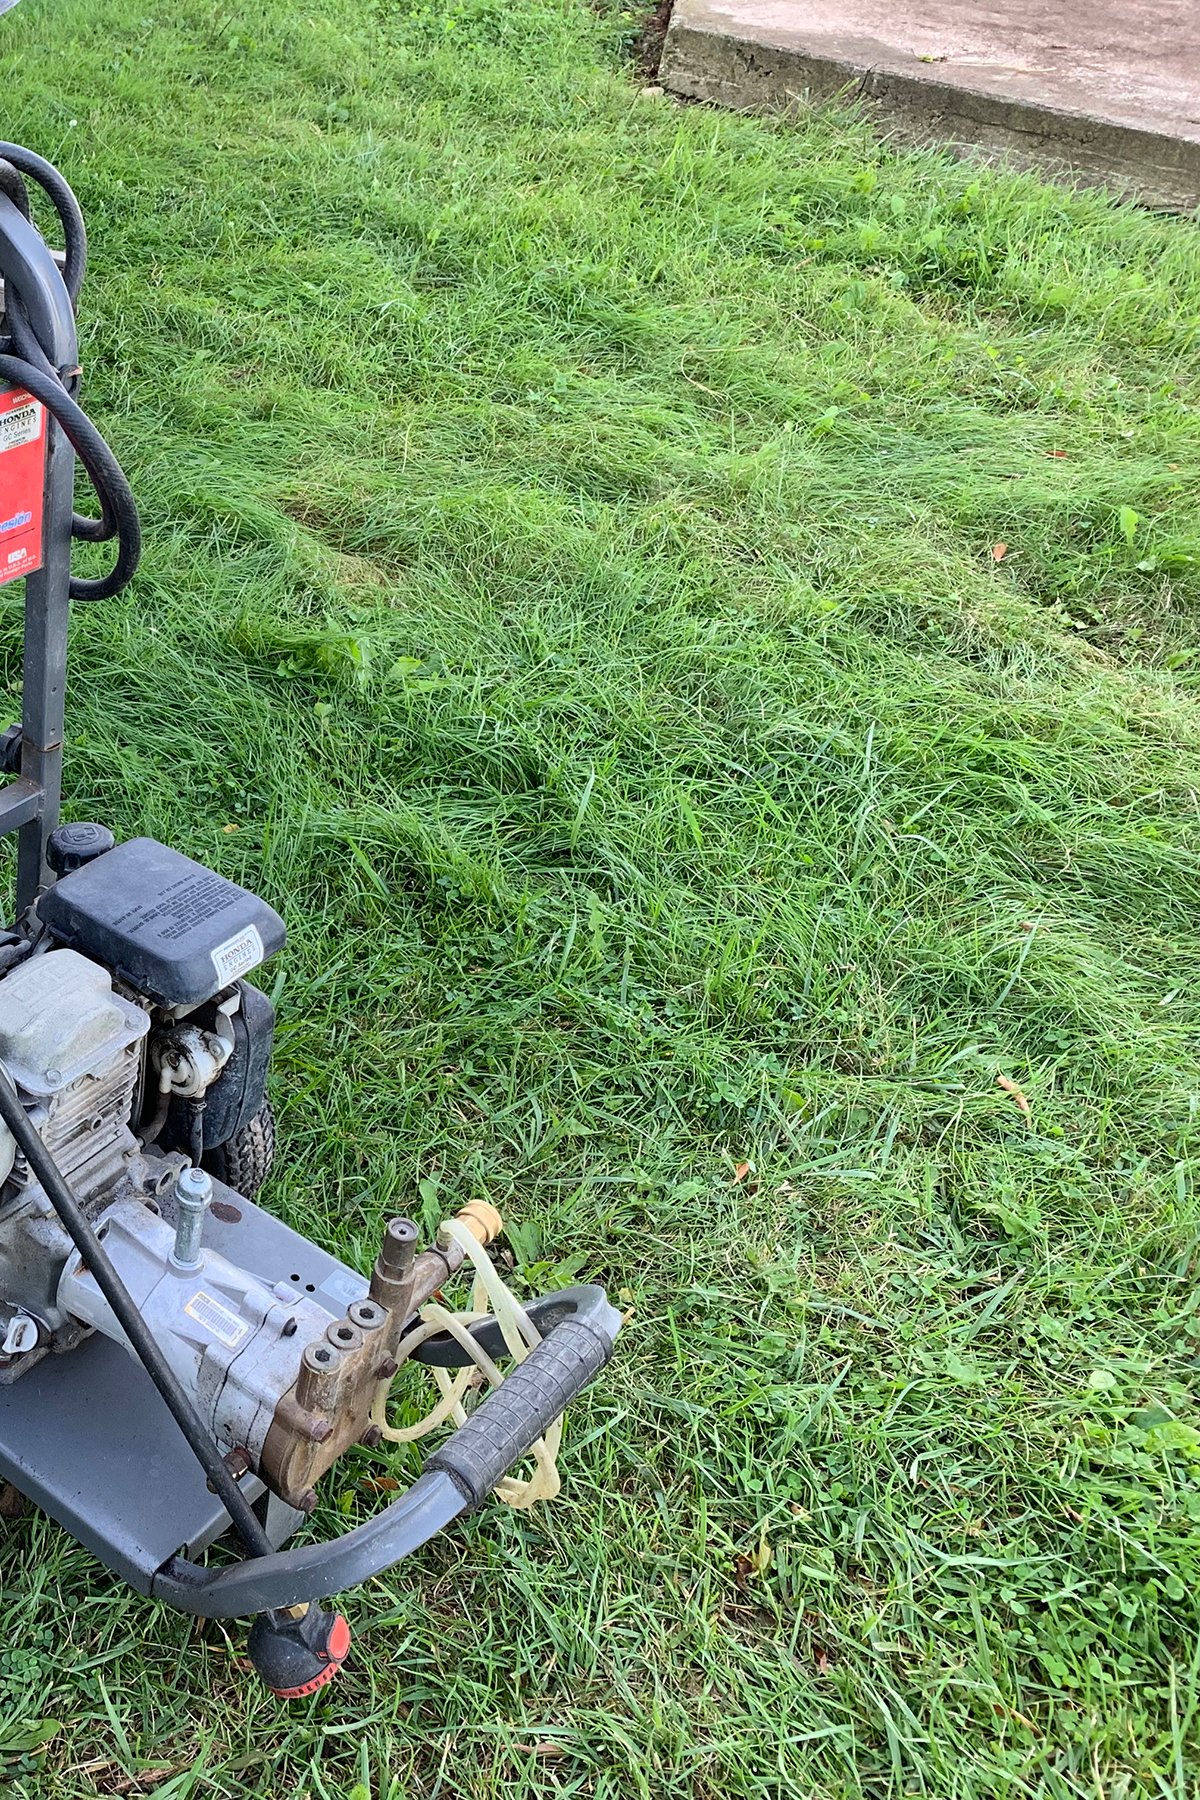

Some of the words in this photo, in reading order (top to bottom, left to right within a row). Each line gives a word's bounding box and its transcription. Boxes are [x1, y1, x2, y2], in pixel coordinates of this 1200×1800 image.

[0, 408, 36, 427] HONDA
[220, 939, 253, 963] HONDA
[223, 946, 256, 971] ENGINES
